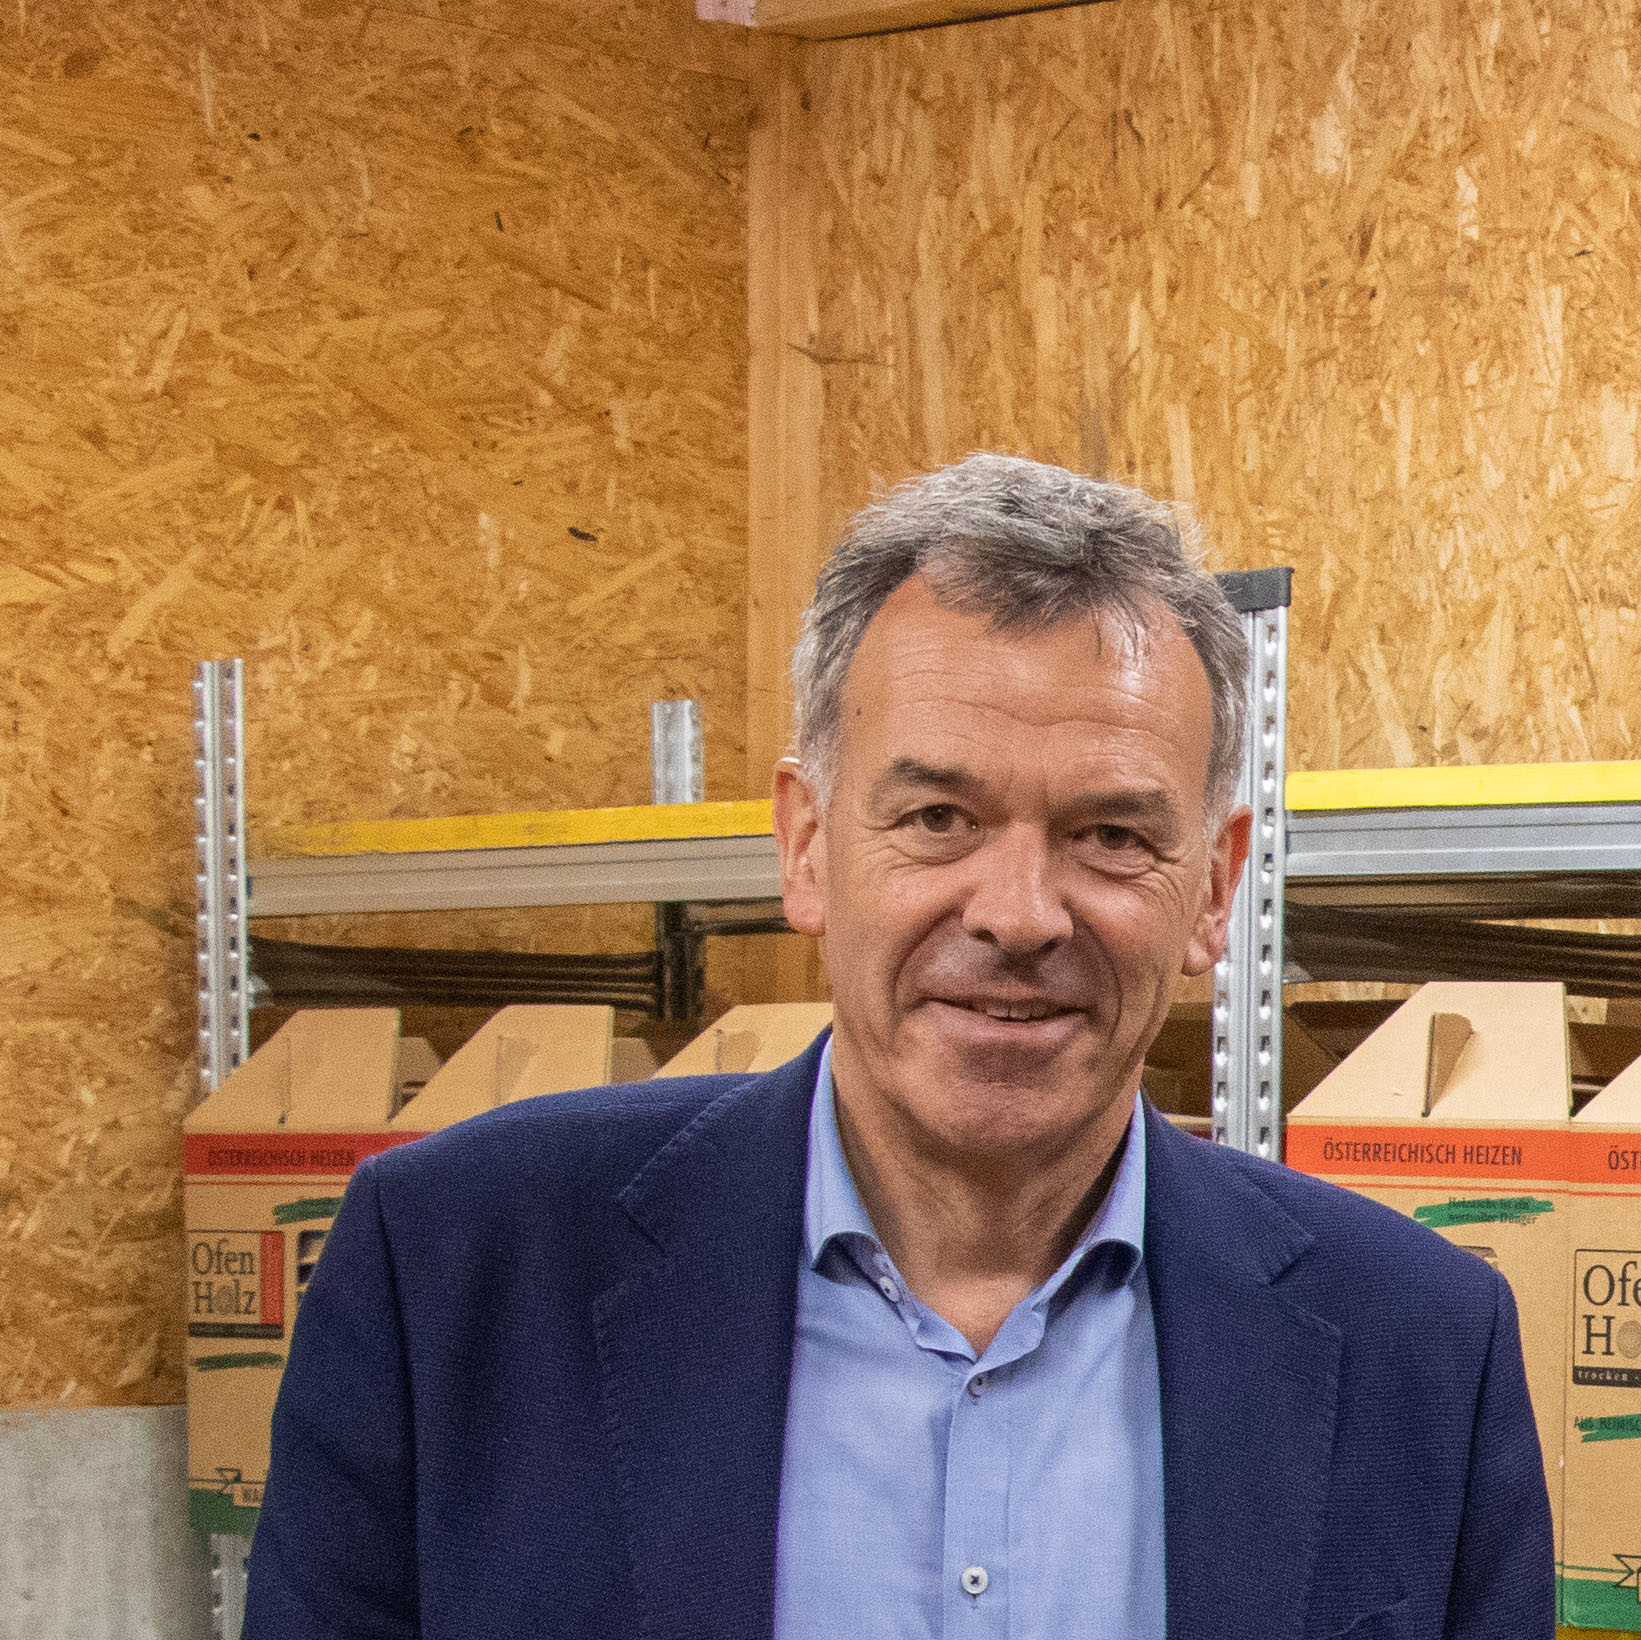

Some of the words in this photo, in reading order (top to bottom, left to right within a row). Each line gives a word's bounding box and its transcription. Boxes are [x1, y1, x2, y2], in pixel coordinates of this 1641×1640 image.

[1323, 1138, 1456, 1165] ÖSTERREICHISCH
[1463, 1145, 1523, 1166] HEIZEN
[192, 1238, 255, 1276] Ofen
[1577, 1369, 1629, 1382] trocken
